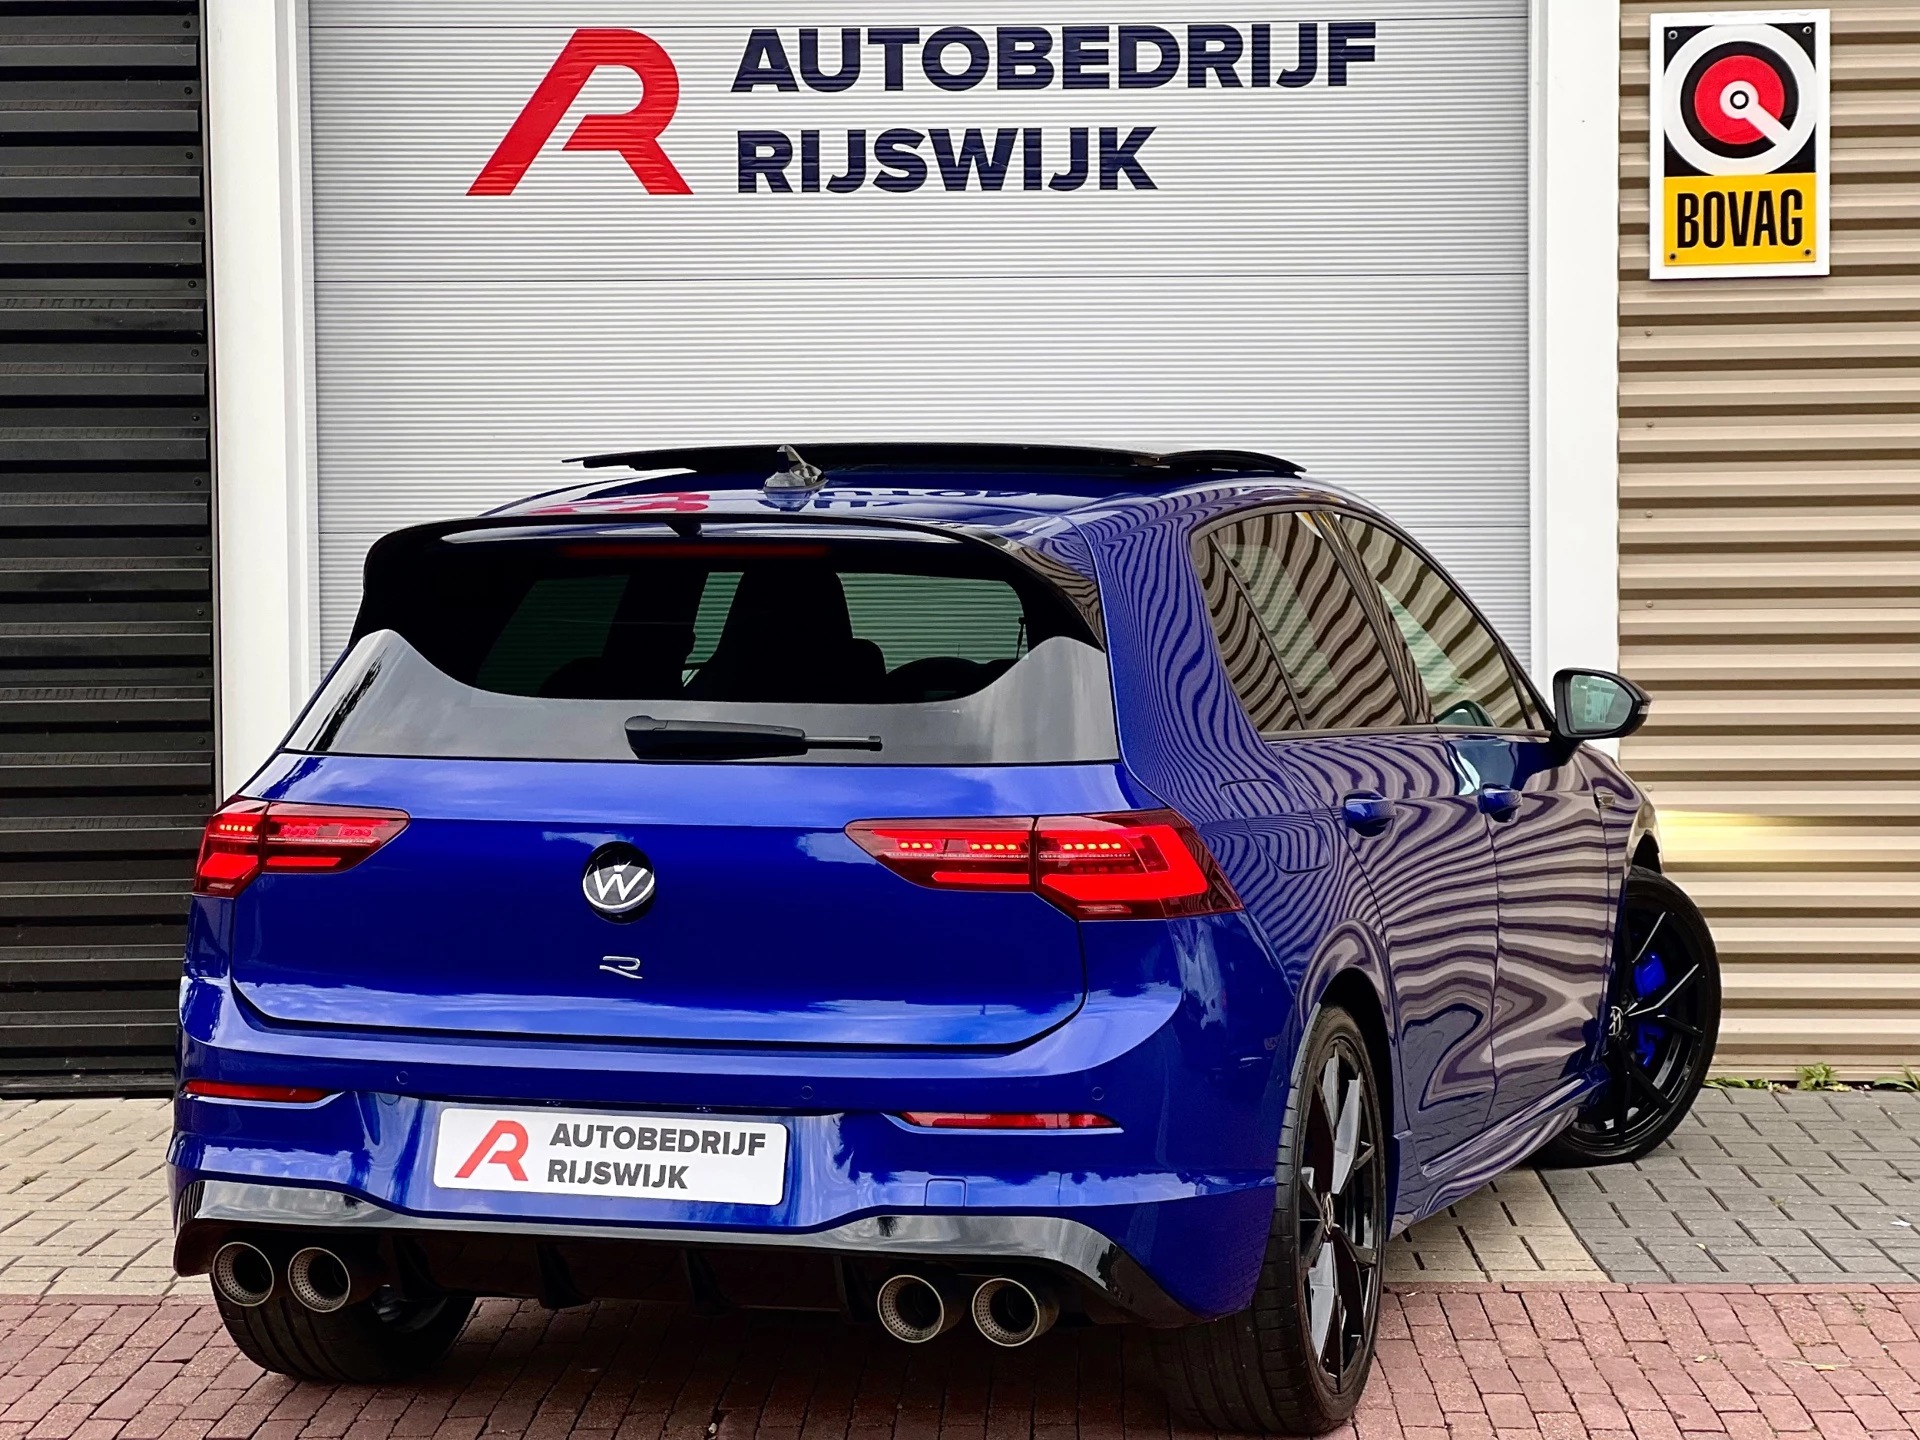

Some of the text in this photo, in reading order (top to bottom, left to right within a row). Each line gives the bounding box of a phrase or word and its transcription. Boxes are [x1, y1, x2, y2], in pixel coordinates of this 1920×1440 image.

[731, 21, 1377, 93] AUTOBEDRIJF
[737, 126, 1157, 194] RIJSWIJK
[1677, 188, 1803, 249] BOVAG
[549, 1122, 767, 1157] AUTOBEDRIJF
[547, 1159, 689, 1190] RIJSWIJK
